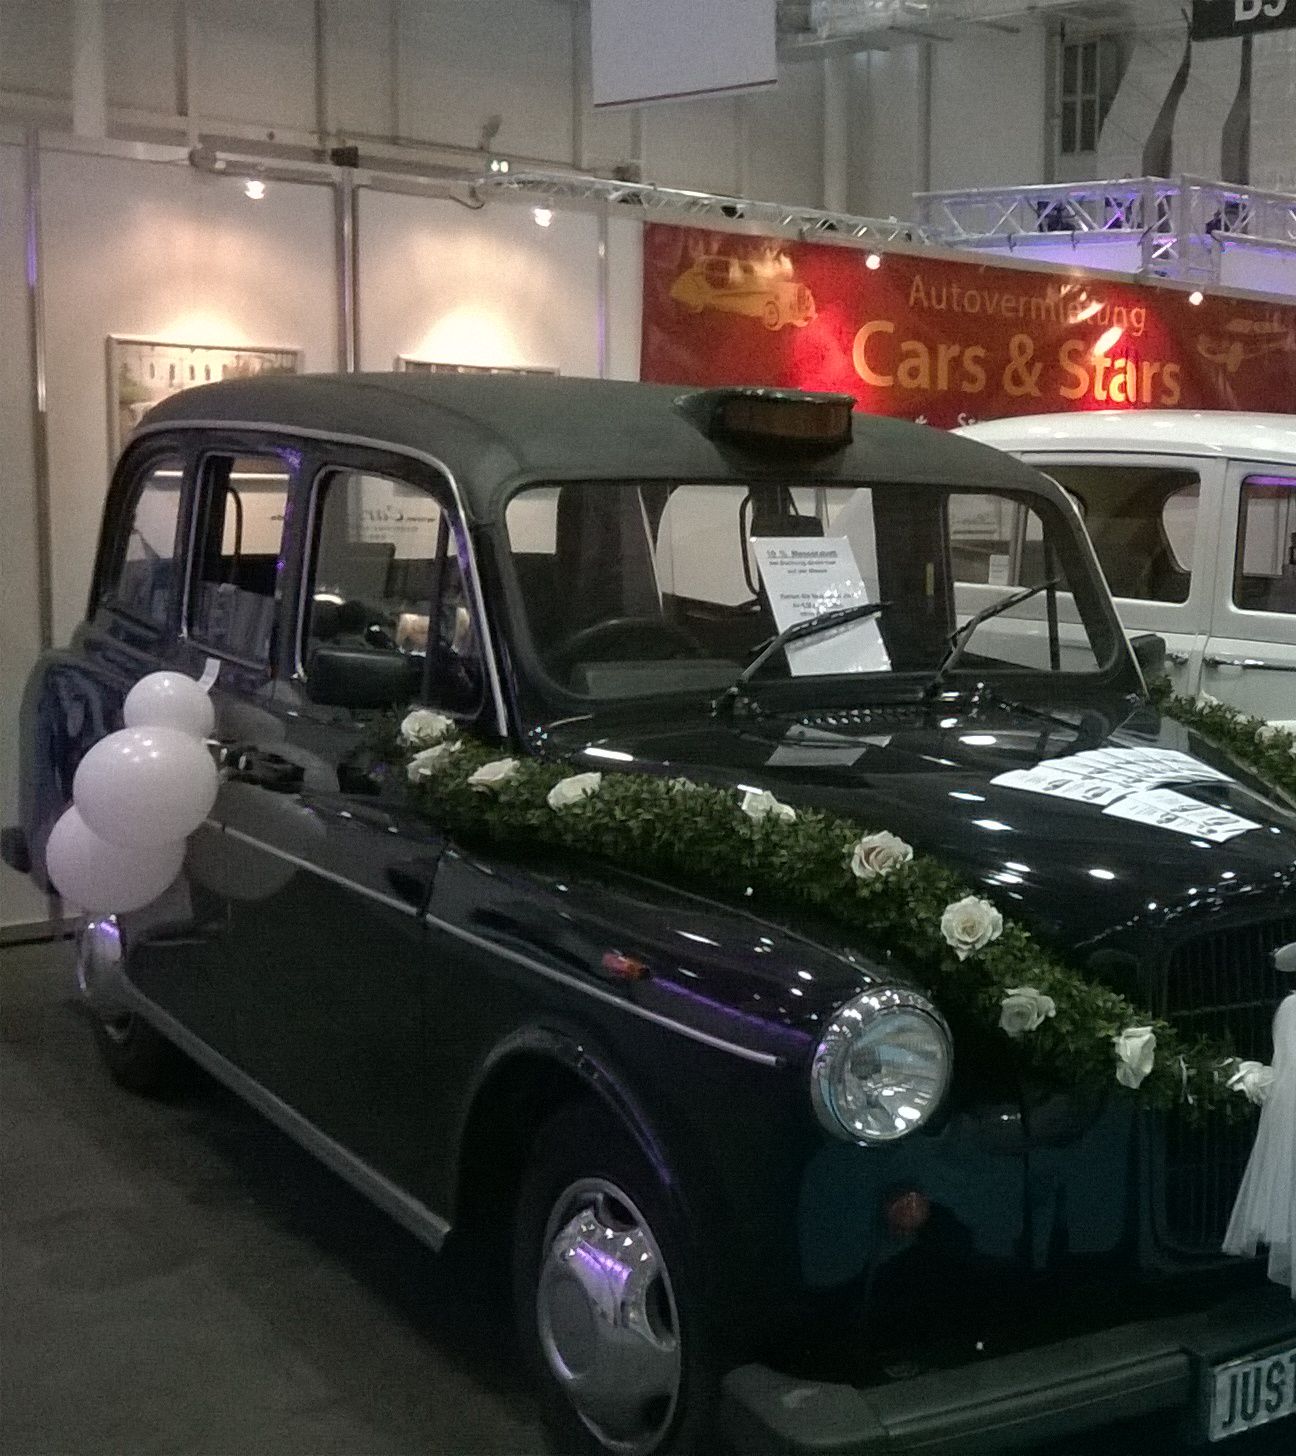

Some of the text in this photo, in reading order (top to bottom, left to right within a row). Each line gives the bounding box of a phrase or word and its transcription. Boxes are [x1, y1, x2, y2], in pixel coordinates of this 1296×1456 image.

[852, 320, 1182, 405] Cars & Stars
